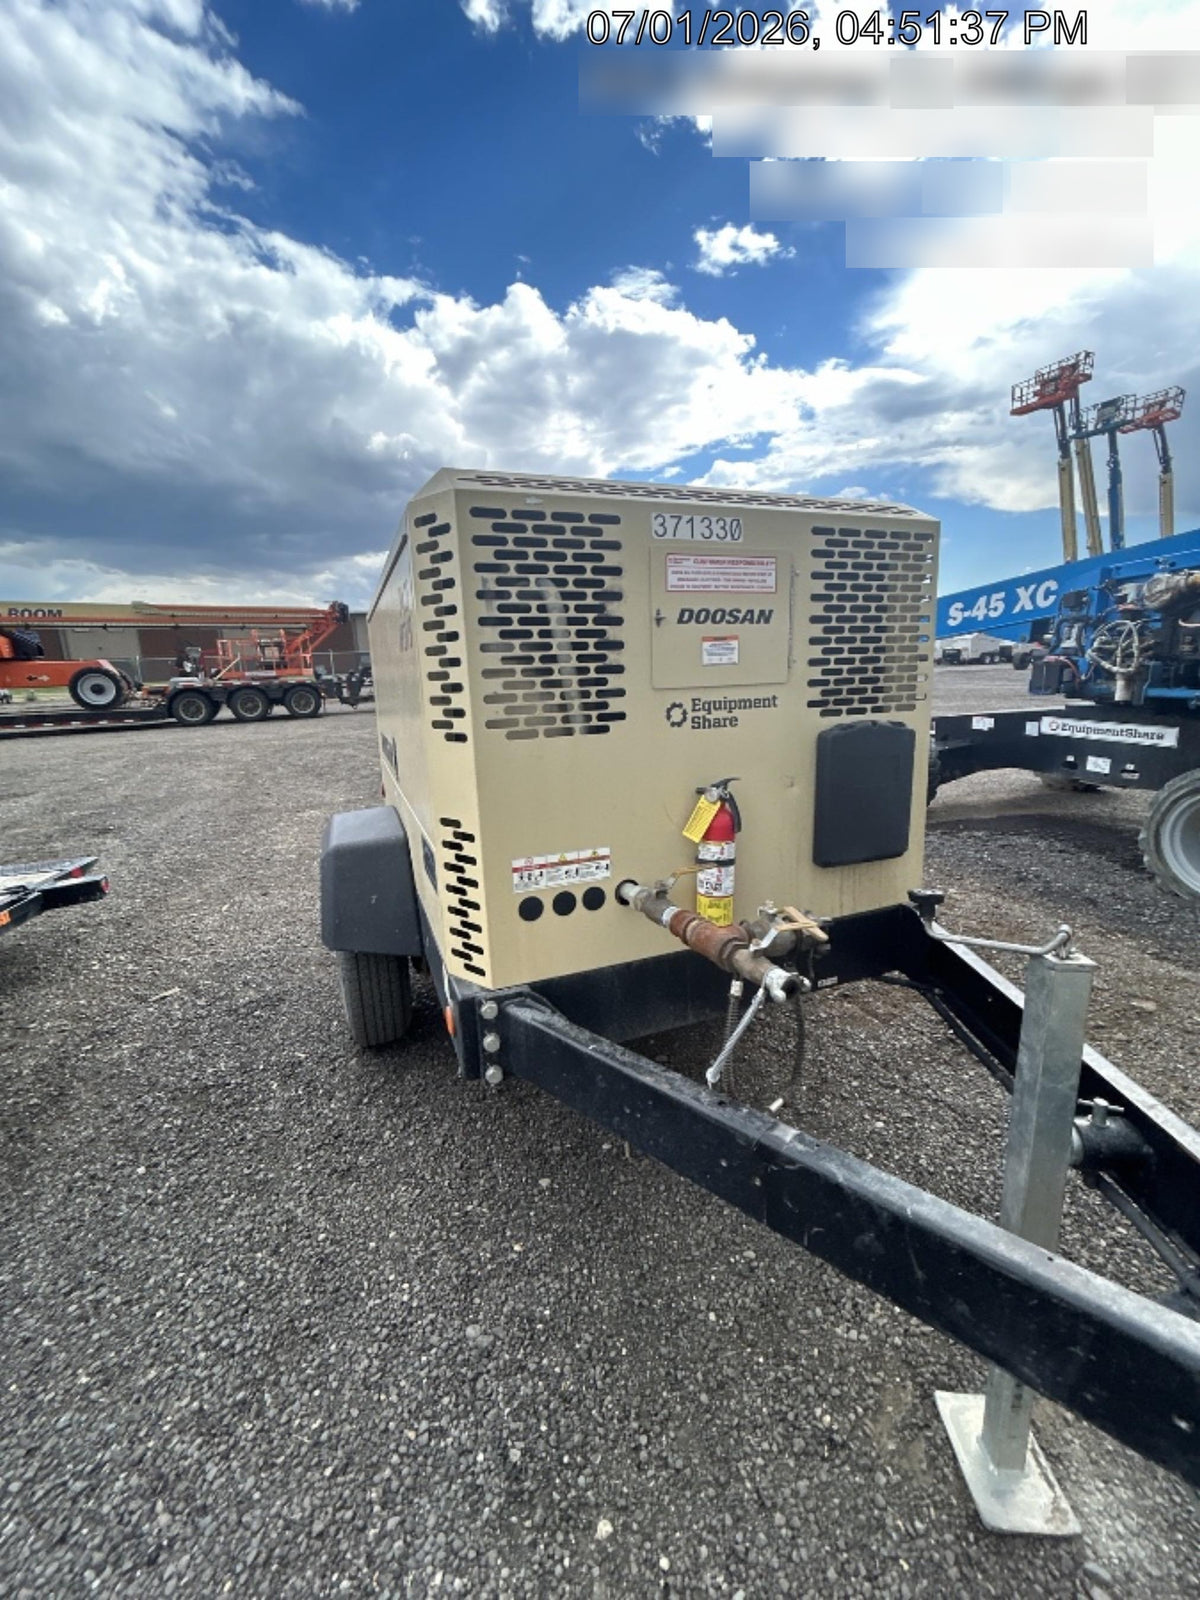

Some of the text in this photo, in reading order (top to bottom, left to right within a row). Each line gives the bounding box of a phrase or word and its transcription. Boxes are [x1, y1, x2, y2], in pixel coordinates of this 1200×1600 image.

[653, 513, 743, 541] 371330
[946, 579, 1059, 627] S-45 XC
[677, 607, 774, 625] DOOSAN
[691, 694, 778, 713] Equipment
[691, 714, 739, 730] Share
[1060, 722, 1165, 741] EquipmentShare
